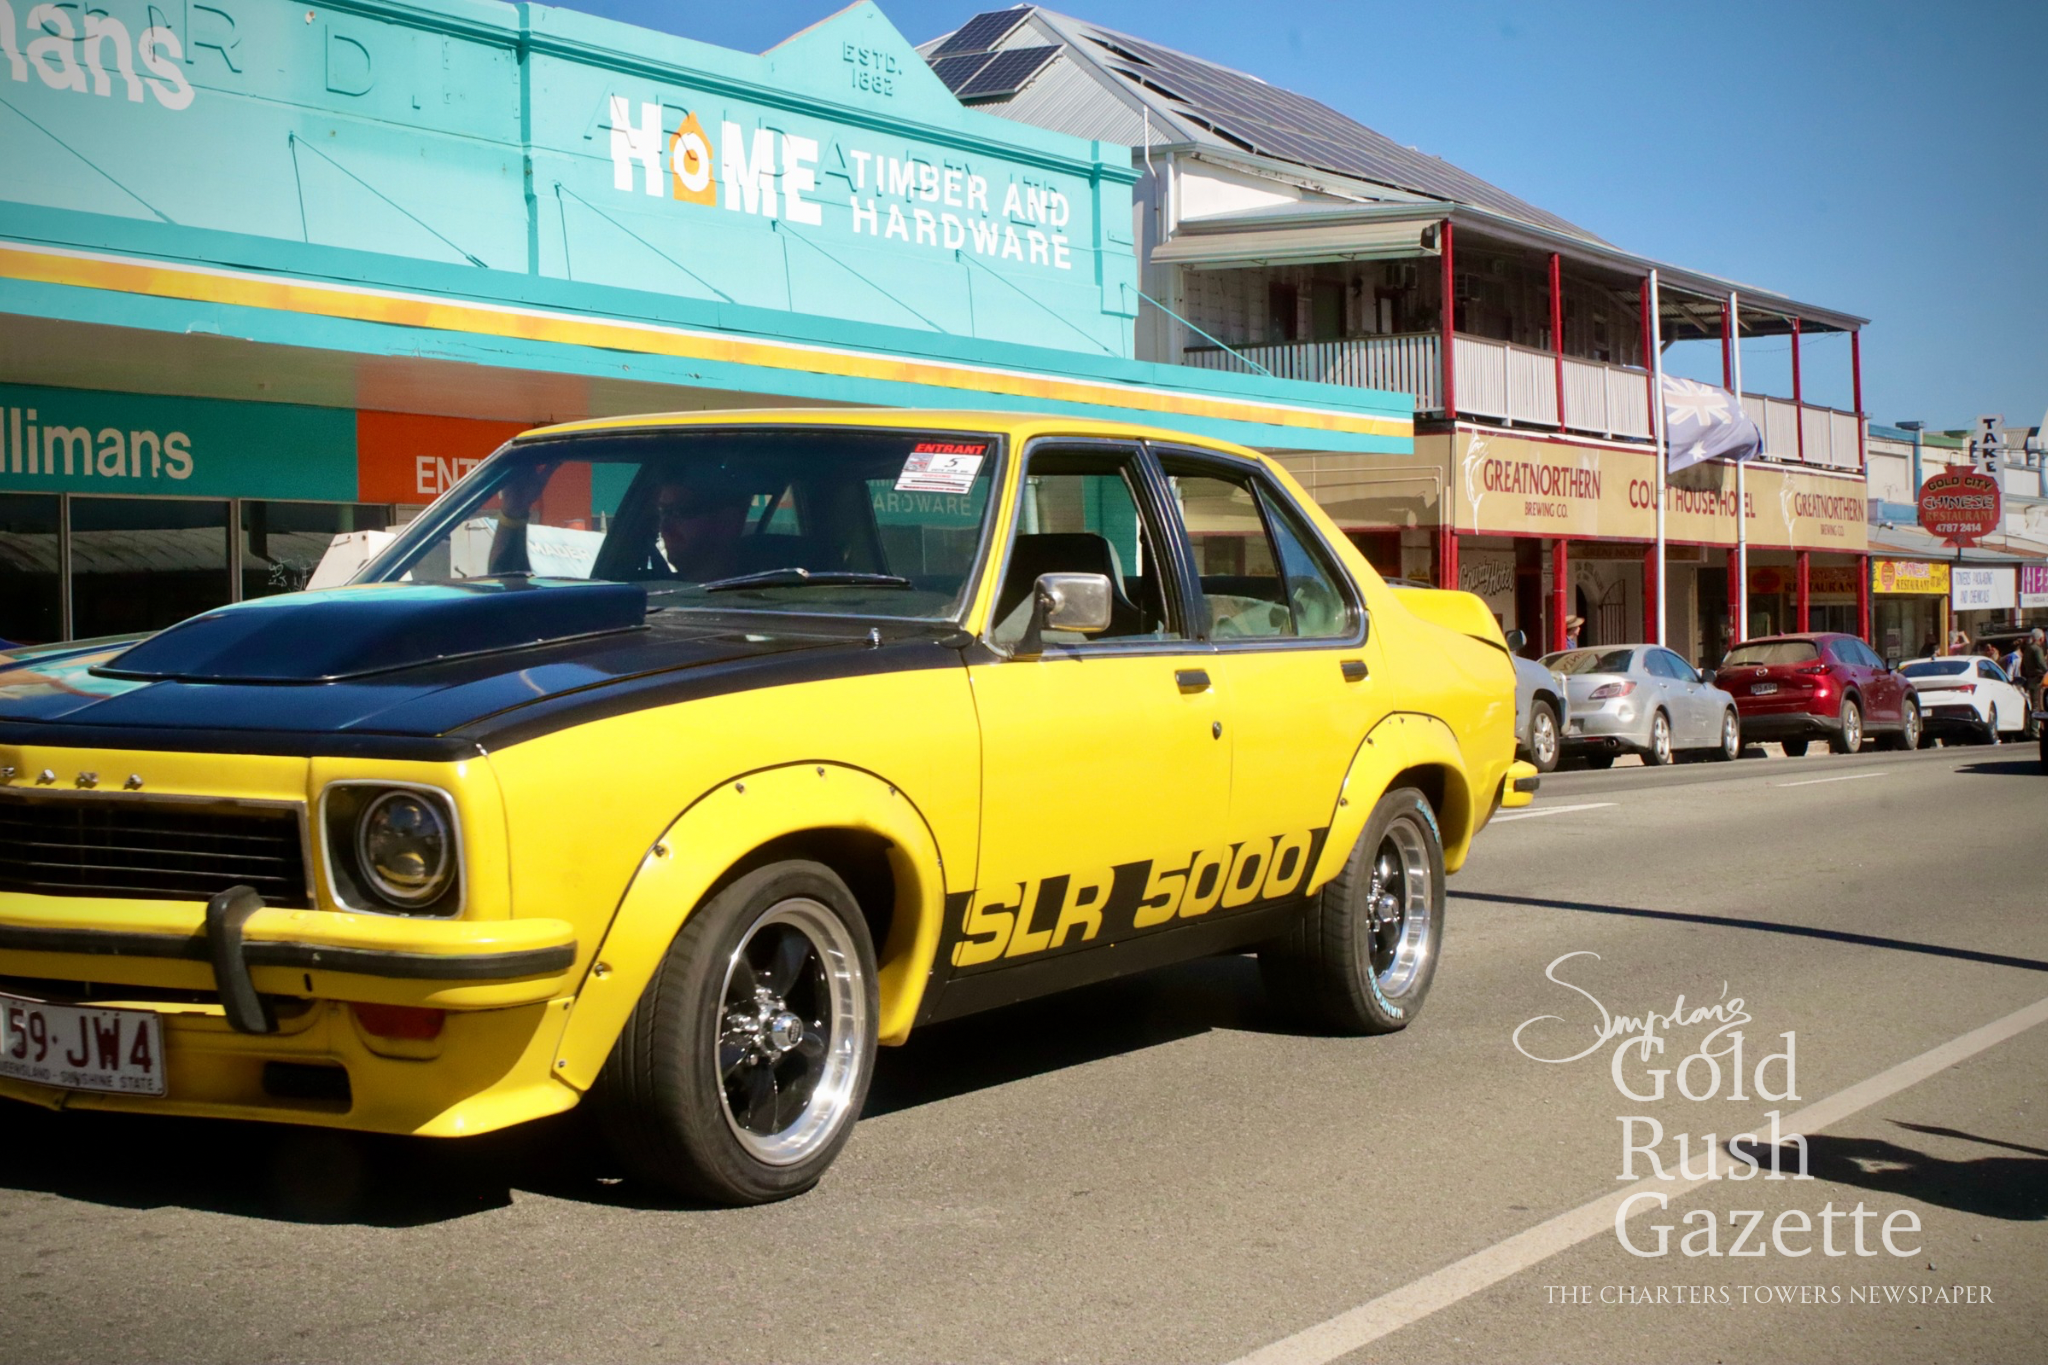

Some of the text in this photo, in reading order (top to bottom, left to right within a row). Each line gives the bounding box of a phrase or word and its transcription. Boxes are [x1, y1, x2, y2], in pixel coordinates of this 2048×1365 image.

[0, 0, 195, 111] ans
[852, 68, 894, 97] 1882
[610, 94, 822, 226] HOME
[850, 149, 1070, 227] TIMBER AND
[851, 196, 1072, 270] HARDWARE
[914, 443, 986, 455] ENTRANT
[1982, 418, 1997, 473] TAKE
[416, 456, 483, 494] ENT
[944, 457, 966, 468] 5
[1629, 479, 1756, 518] COUT HOUSE HOEL
[1927, 476, 1993, 491] GOLD CITY
[1525, 502, 1569, 518] BREWING CO.
[1922, 494, 1995, 510] CHINESE
[1925, 511, 1994, 521] RESTAURANT
[1936, 523, 1982, 532] 4787 2414
[951, 829, 1313, 968] SLR 5000
